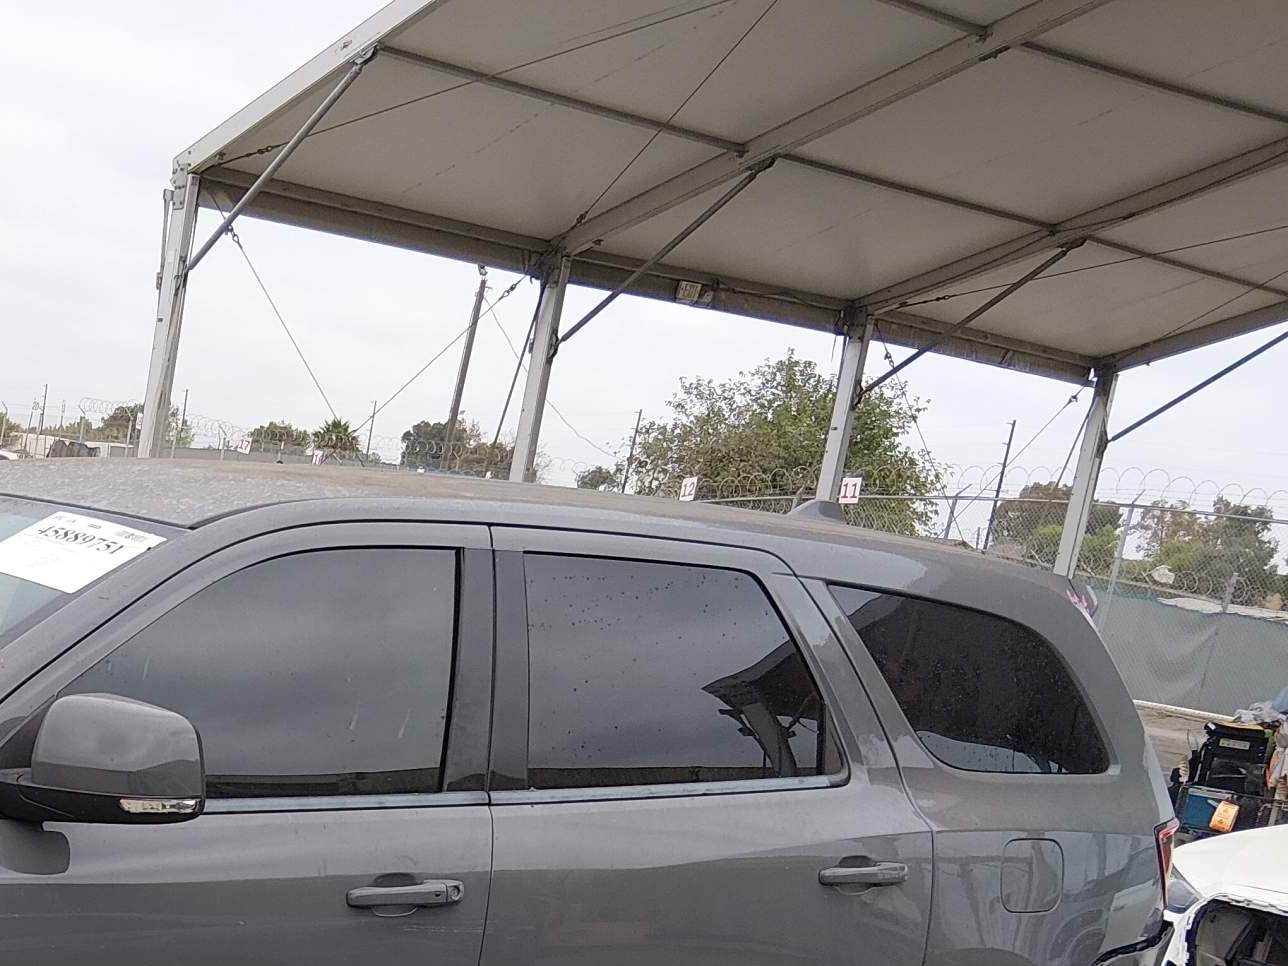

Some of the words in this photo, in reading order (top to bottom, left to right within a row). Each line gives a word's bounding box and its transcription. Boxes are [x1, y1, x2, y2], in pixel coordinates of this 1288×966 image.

[681, 482, 696, 497] 12
[841, 482, 859, 499] 11
[35, 525, 126, 555] 45889751
